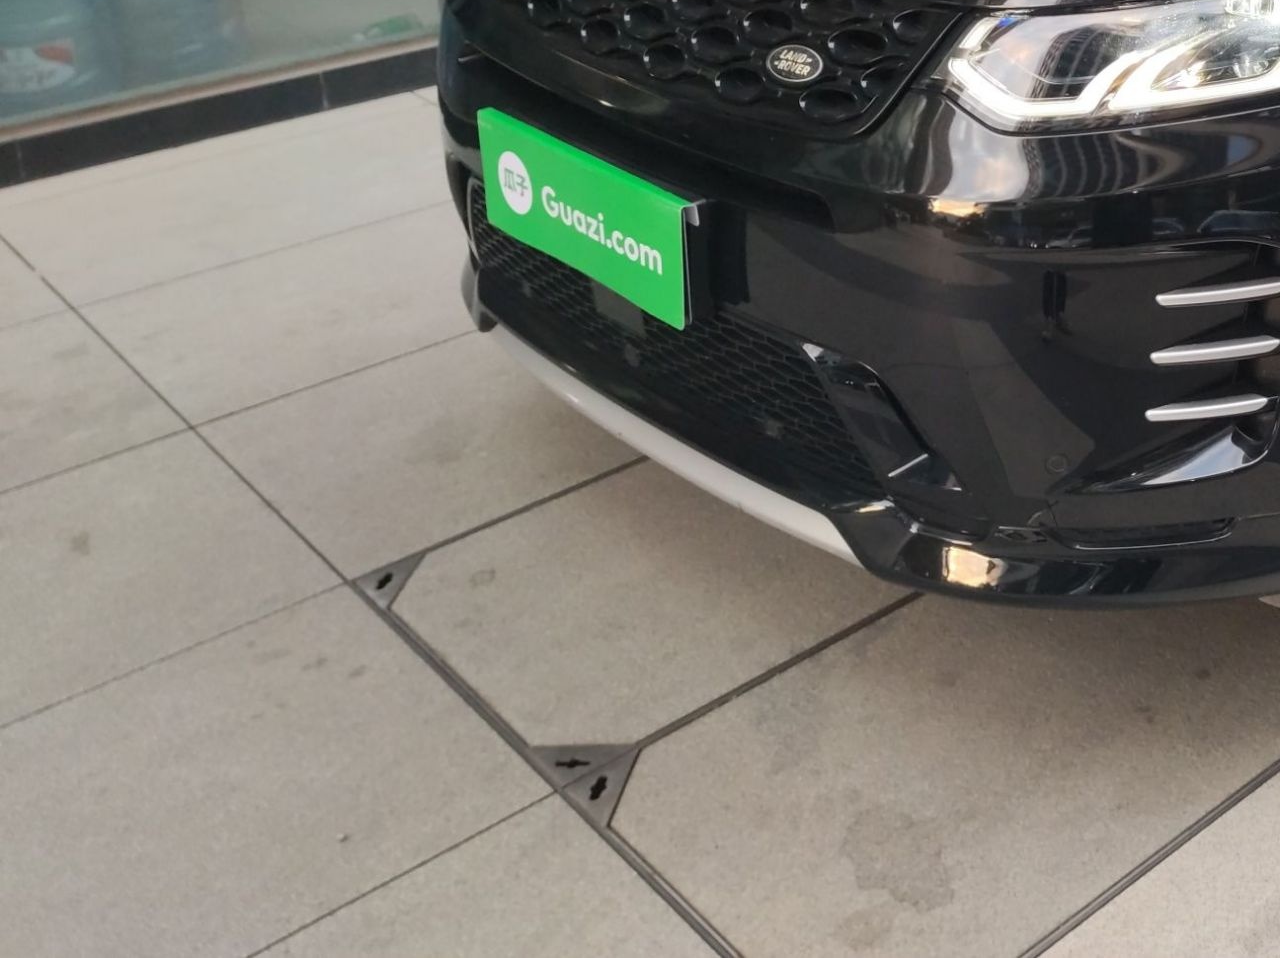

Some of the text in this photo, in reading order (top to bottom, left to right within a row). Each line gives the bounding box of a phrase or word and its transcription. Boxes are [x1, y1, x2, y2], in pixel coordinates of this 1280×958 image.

[779, 49, 808, 63] LAND
[777, 59, 811, 76] ROVER
[504, 167, 663, 275] 瓜子 Guazi.com
